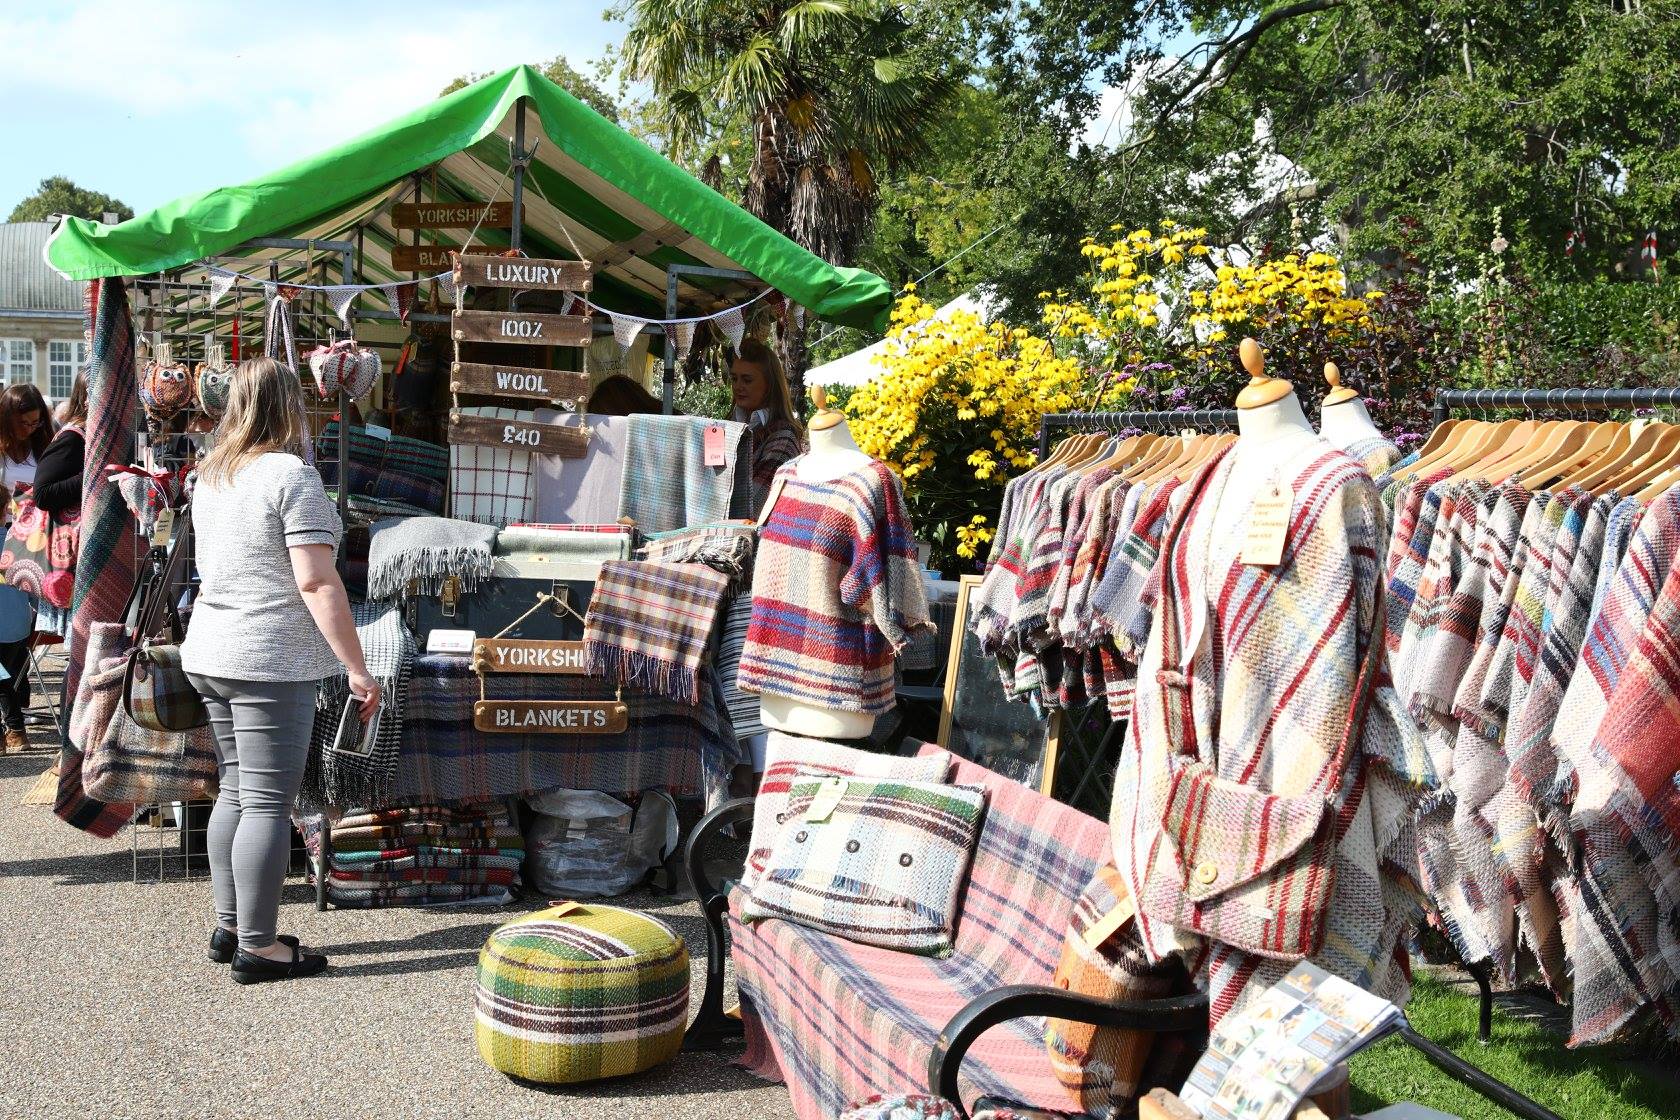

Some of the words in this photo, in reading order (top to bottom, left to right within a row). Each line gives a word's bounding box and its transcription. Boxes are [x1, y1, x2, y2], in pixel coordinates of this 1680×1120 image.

[417, 208, 498, 223] YORKSHIRE
[486, 264, 562, 284] LUXURY
[501, 319, 543, 338] 100%
[496, 372, 549, 393] WOOL
[502, 425, 540, 446] £40
[496, 646, 584, 667] YORKSHI
[496, 709, 606, 727] BLANKETS
